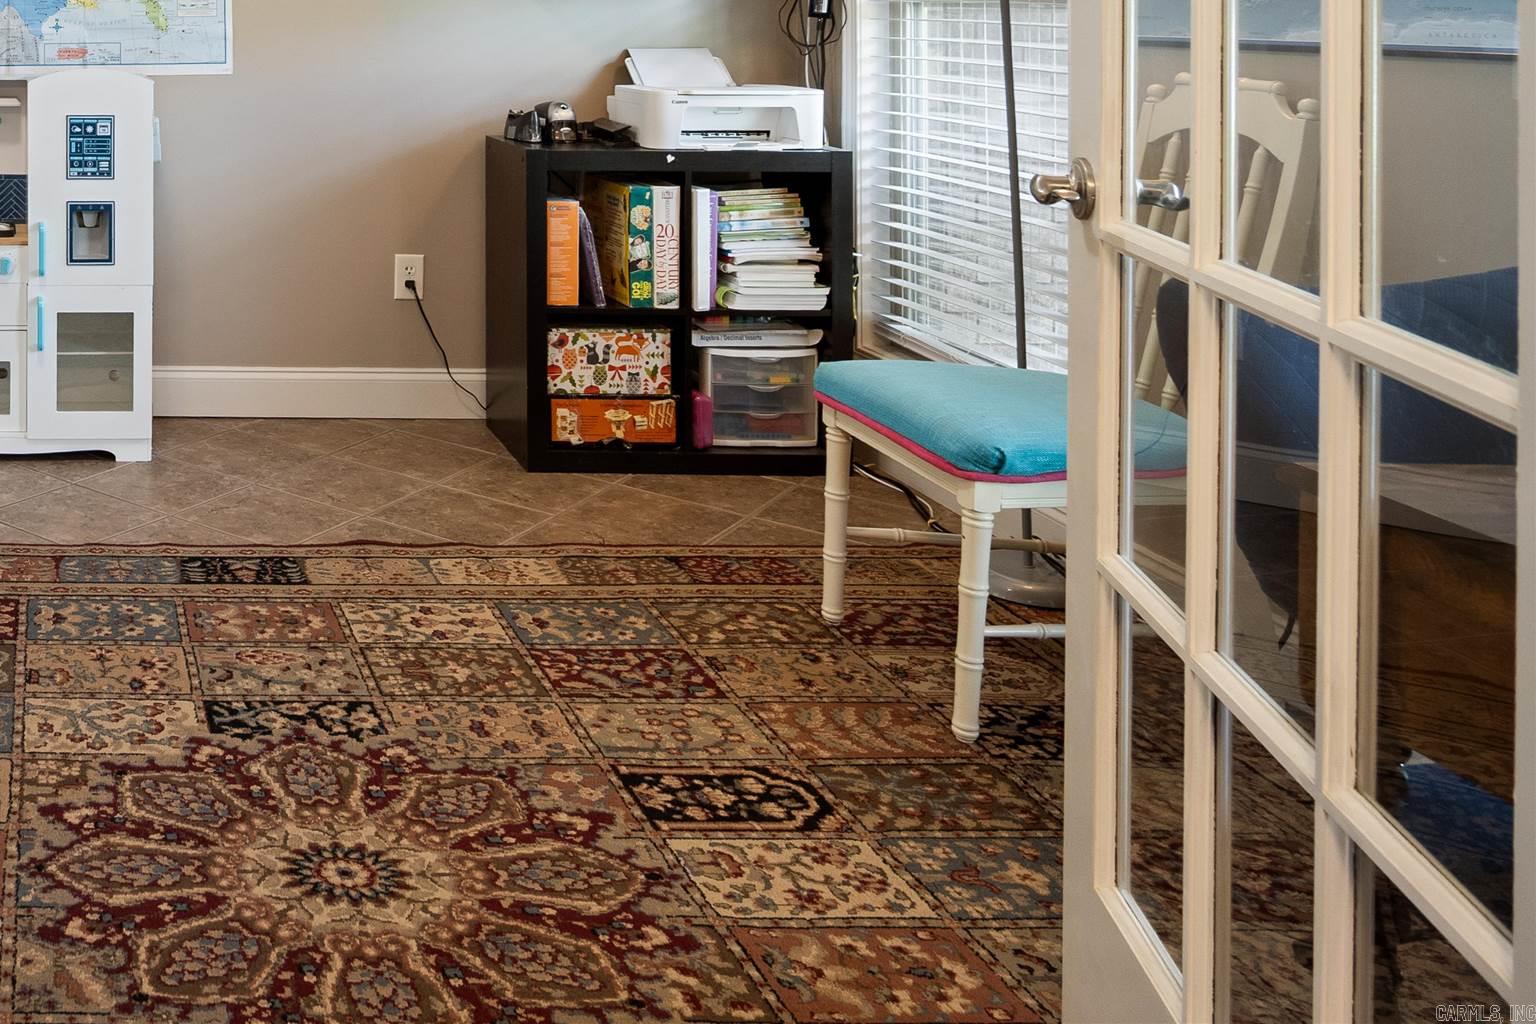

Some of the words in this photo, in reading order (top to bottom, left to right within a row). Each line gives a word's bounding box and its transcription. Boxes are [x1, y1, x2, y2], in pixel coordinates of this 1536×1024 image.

[655, 236, 667, 259] DAY
[667, 238, 680, 291] CENTURY
[655, 270, 667, 291] DAY
[700, 334, 720, 342] Algebra
